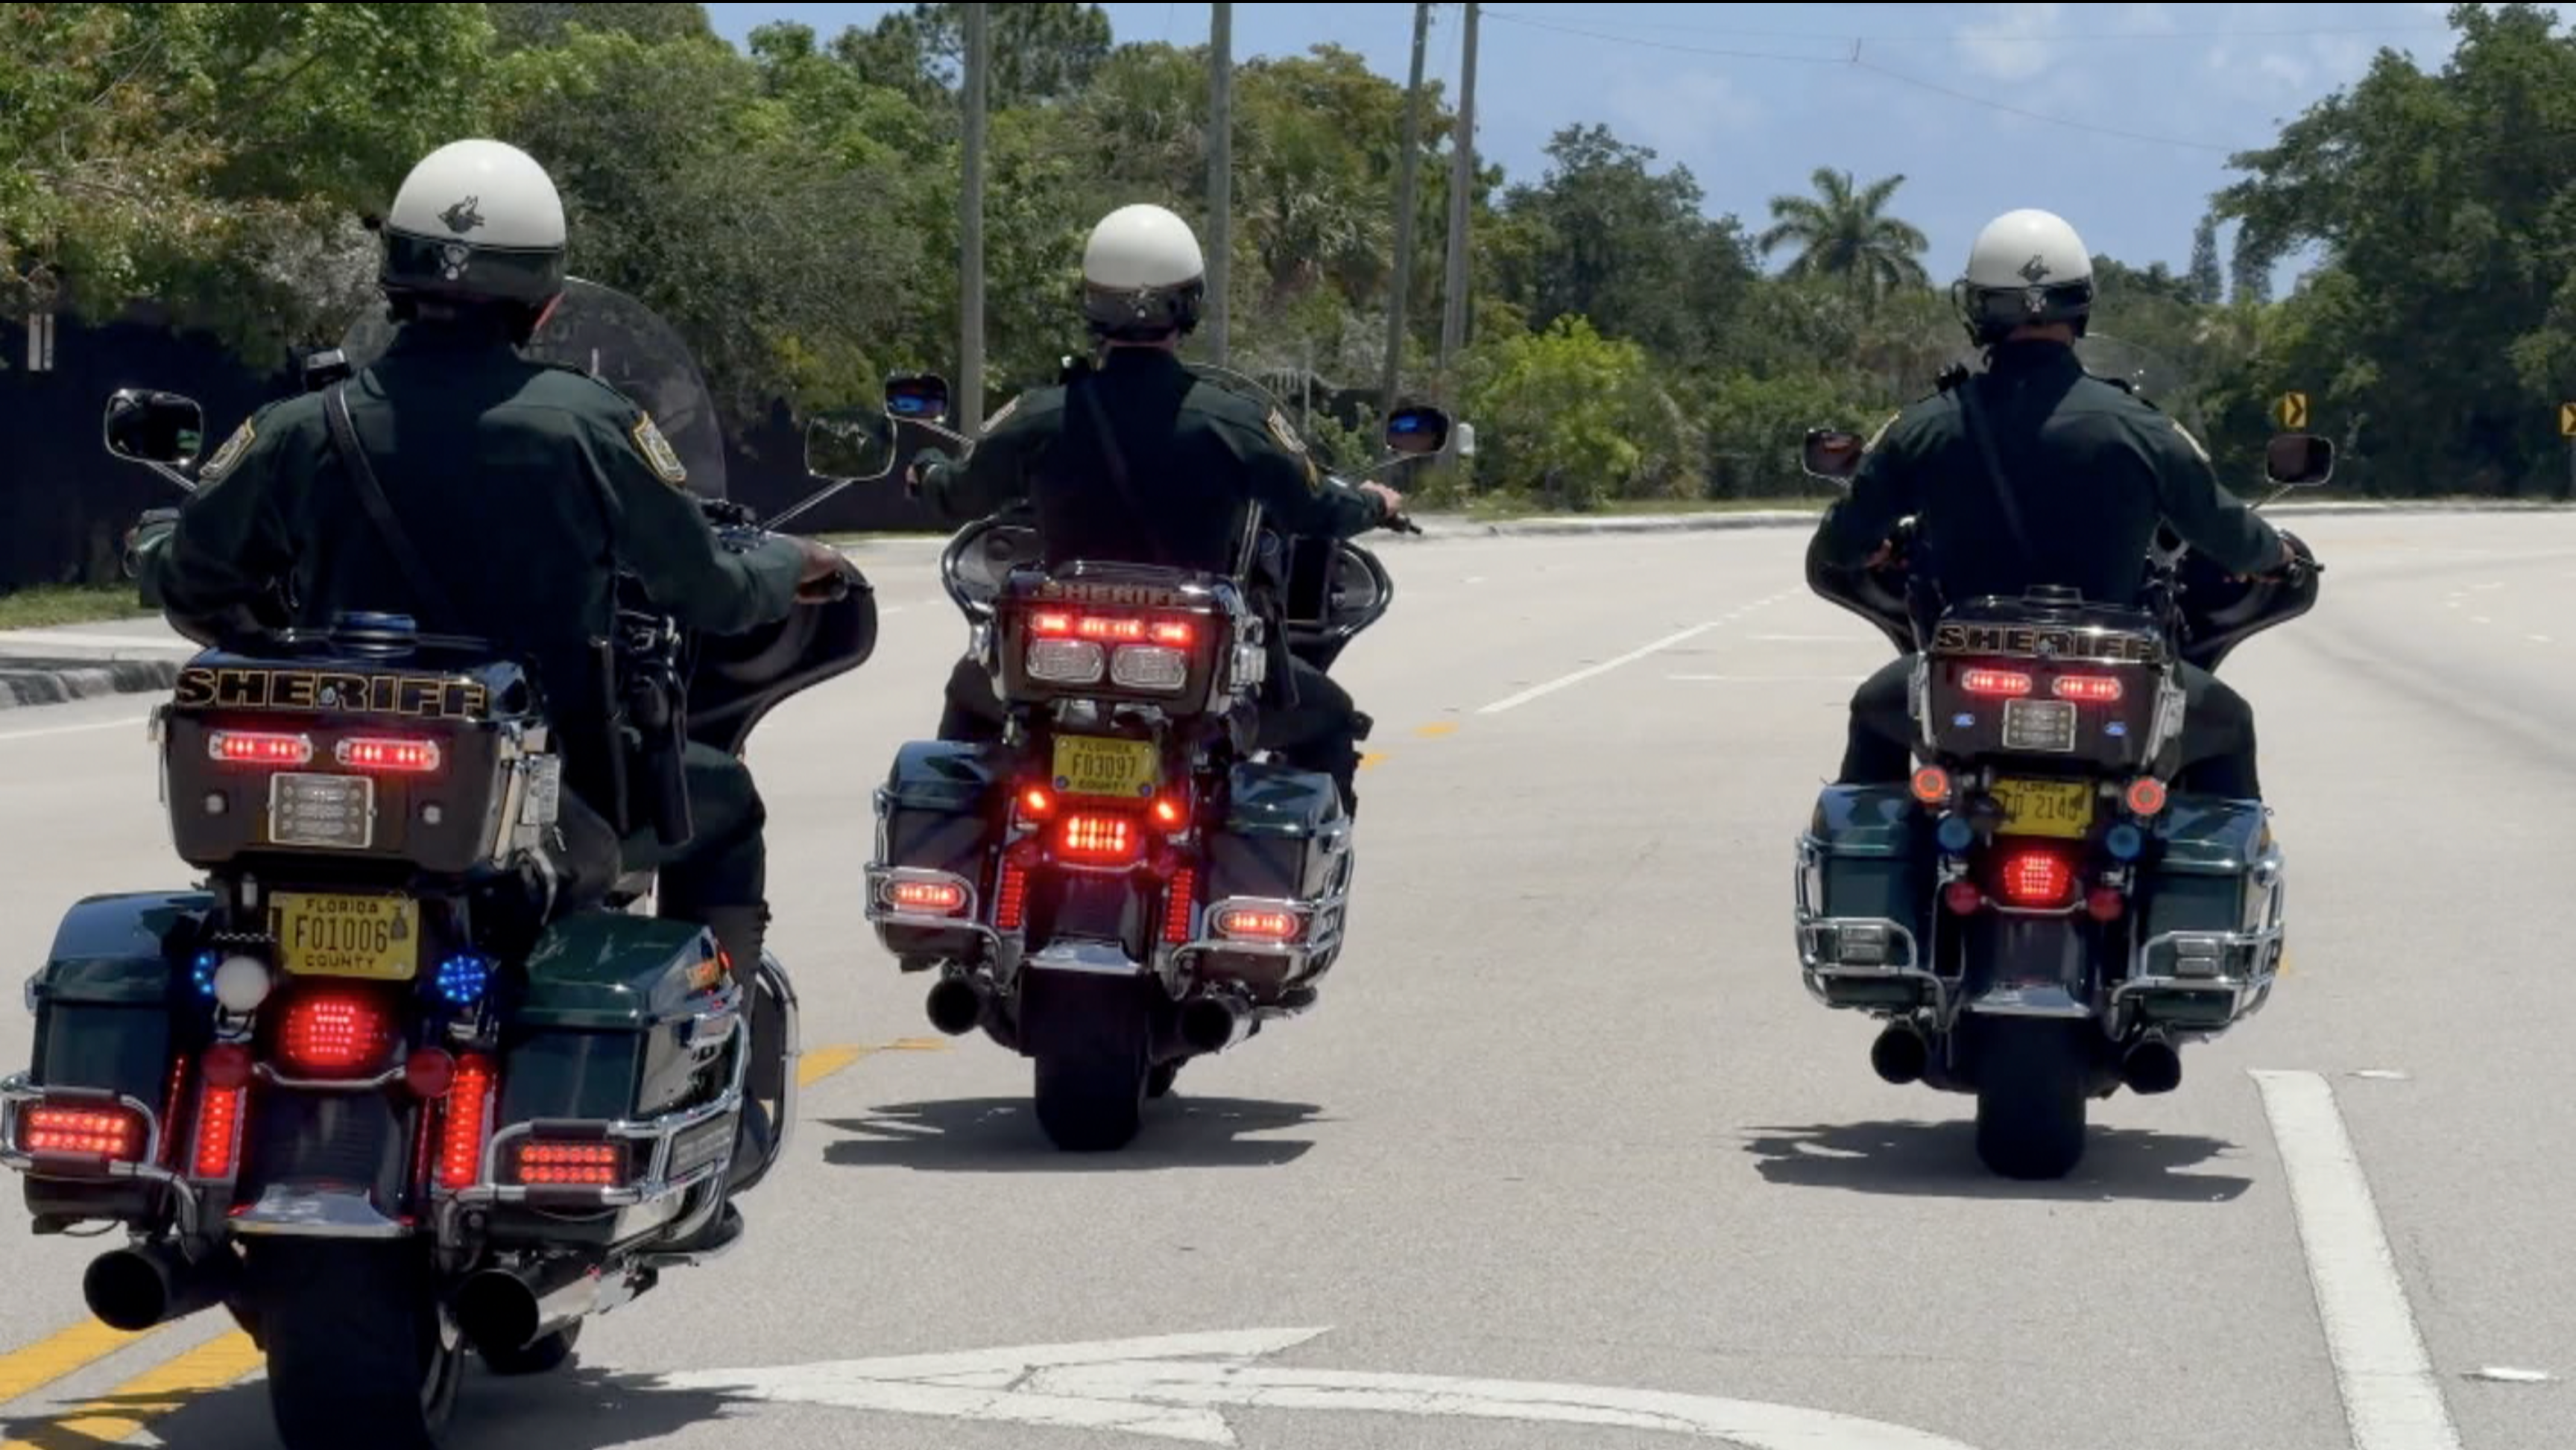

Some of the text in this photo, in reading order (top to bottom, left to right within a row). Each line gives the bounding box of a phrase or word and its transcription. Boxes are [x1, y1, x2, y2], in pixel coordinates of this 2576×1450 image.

[1936, 624, 2154, 662] SHERIFF
[175, 668, 489, 718] SHERIFF
[1073, 753, 1137, 779] F03097
[306, 899, 379, 914] FLORIDA
[295, 914, 388, 954] F01006
[305, 954, 376, 968] COUNTY
